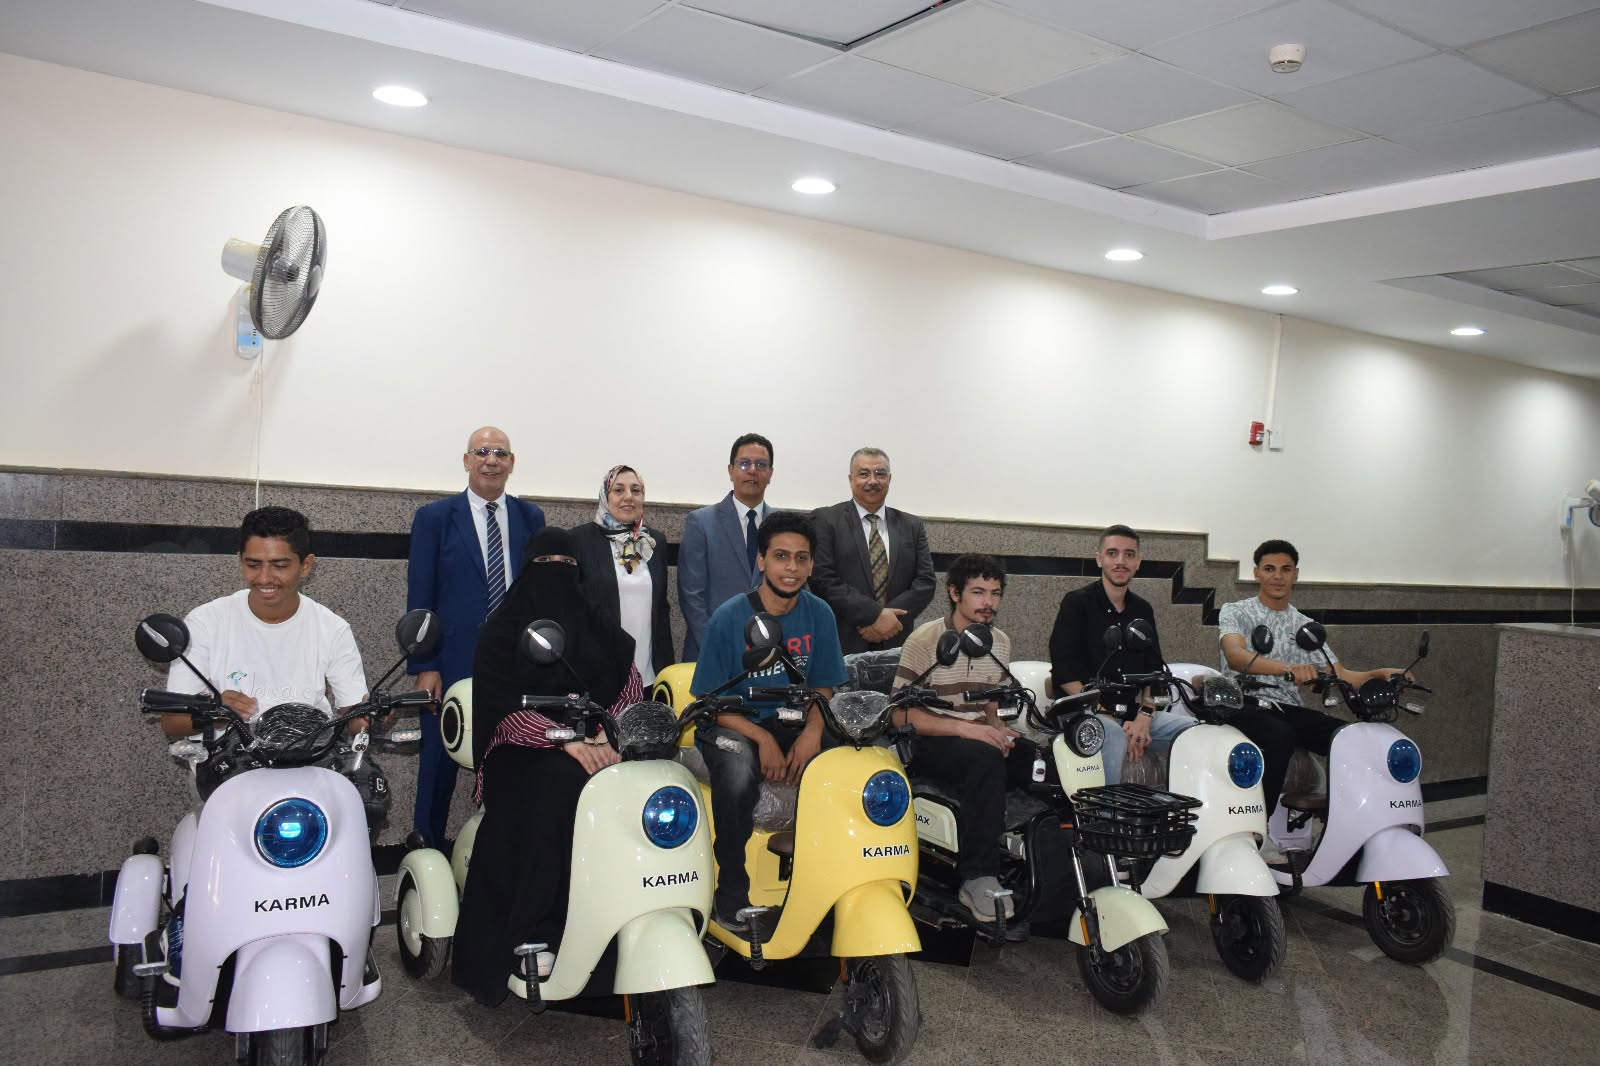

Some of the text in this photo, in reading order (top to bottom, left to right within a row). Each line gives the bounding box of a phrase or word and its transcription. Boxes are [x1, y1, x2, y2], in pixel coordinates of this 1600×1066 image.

[1076, 764, 1100, 773] KARMA
[1228, 804, 1264, 815] KARMA
[1389, 799, 1423, 809] KARMA
[862, 844, 910, 858] KARMA
[642, 870, 699, 888] KARMA
[254, 893, 330, 913] KARMA
